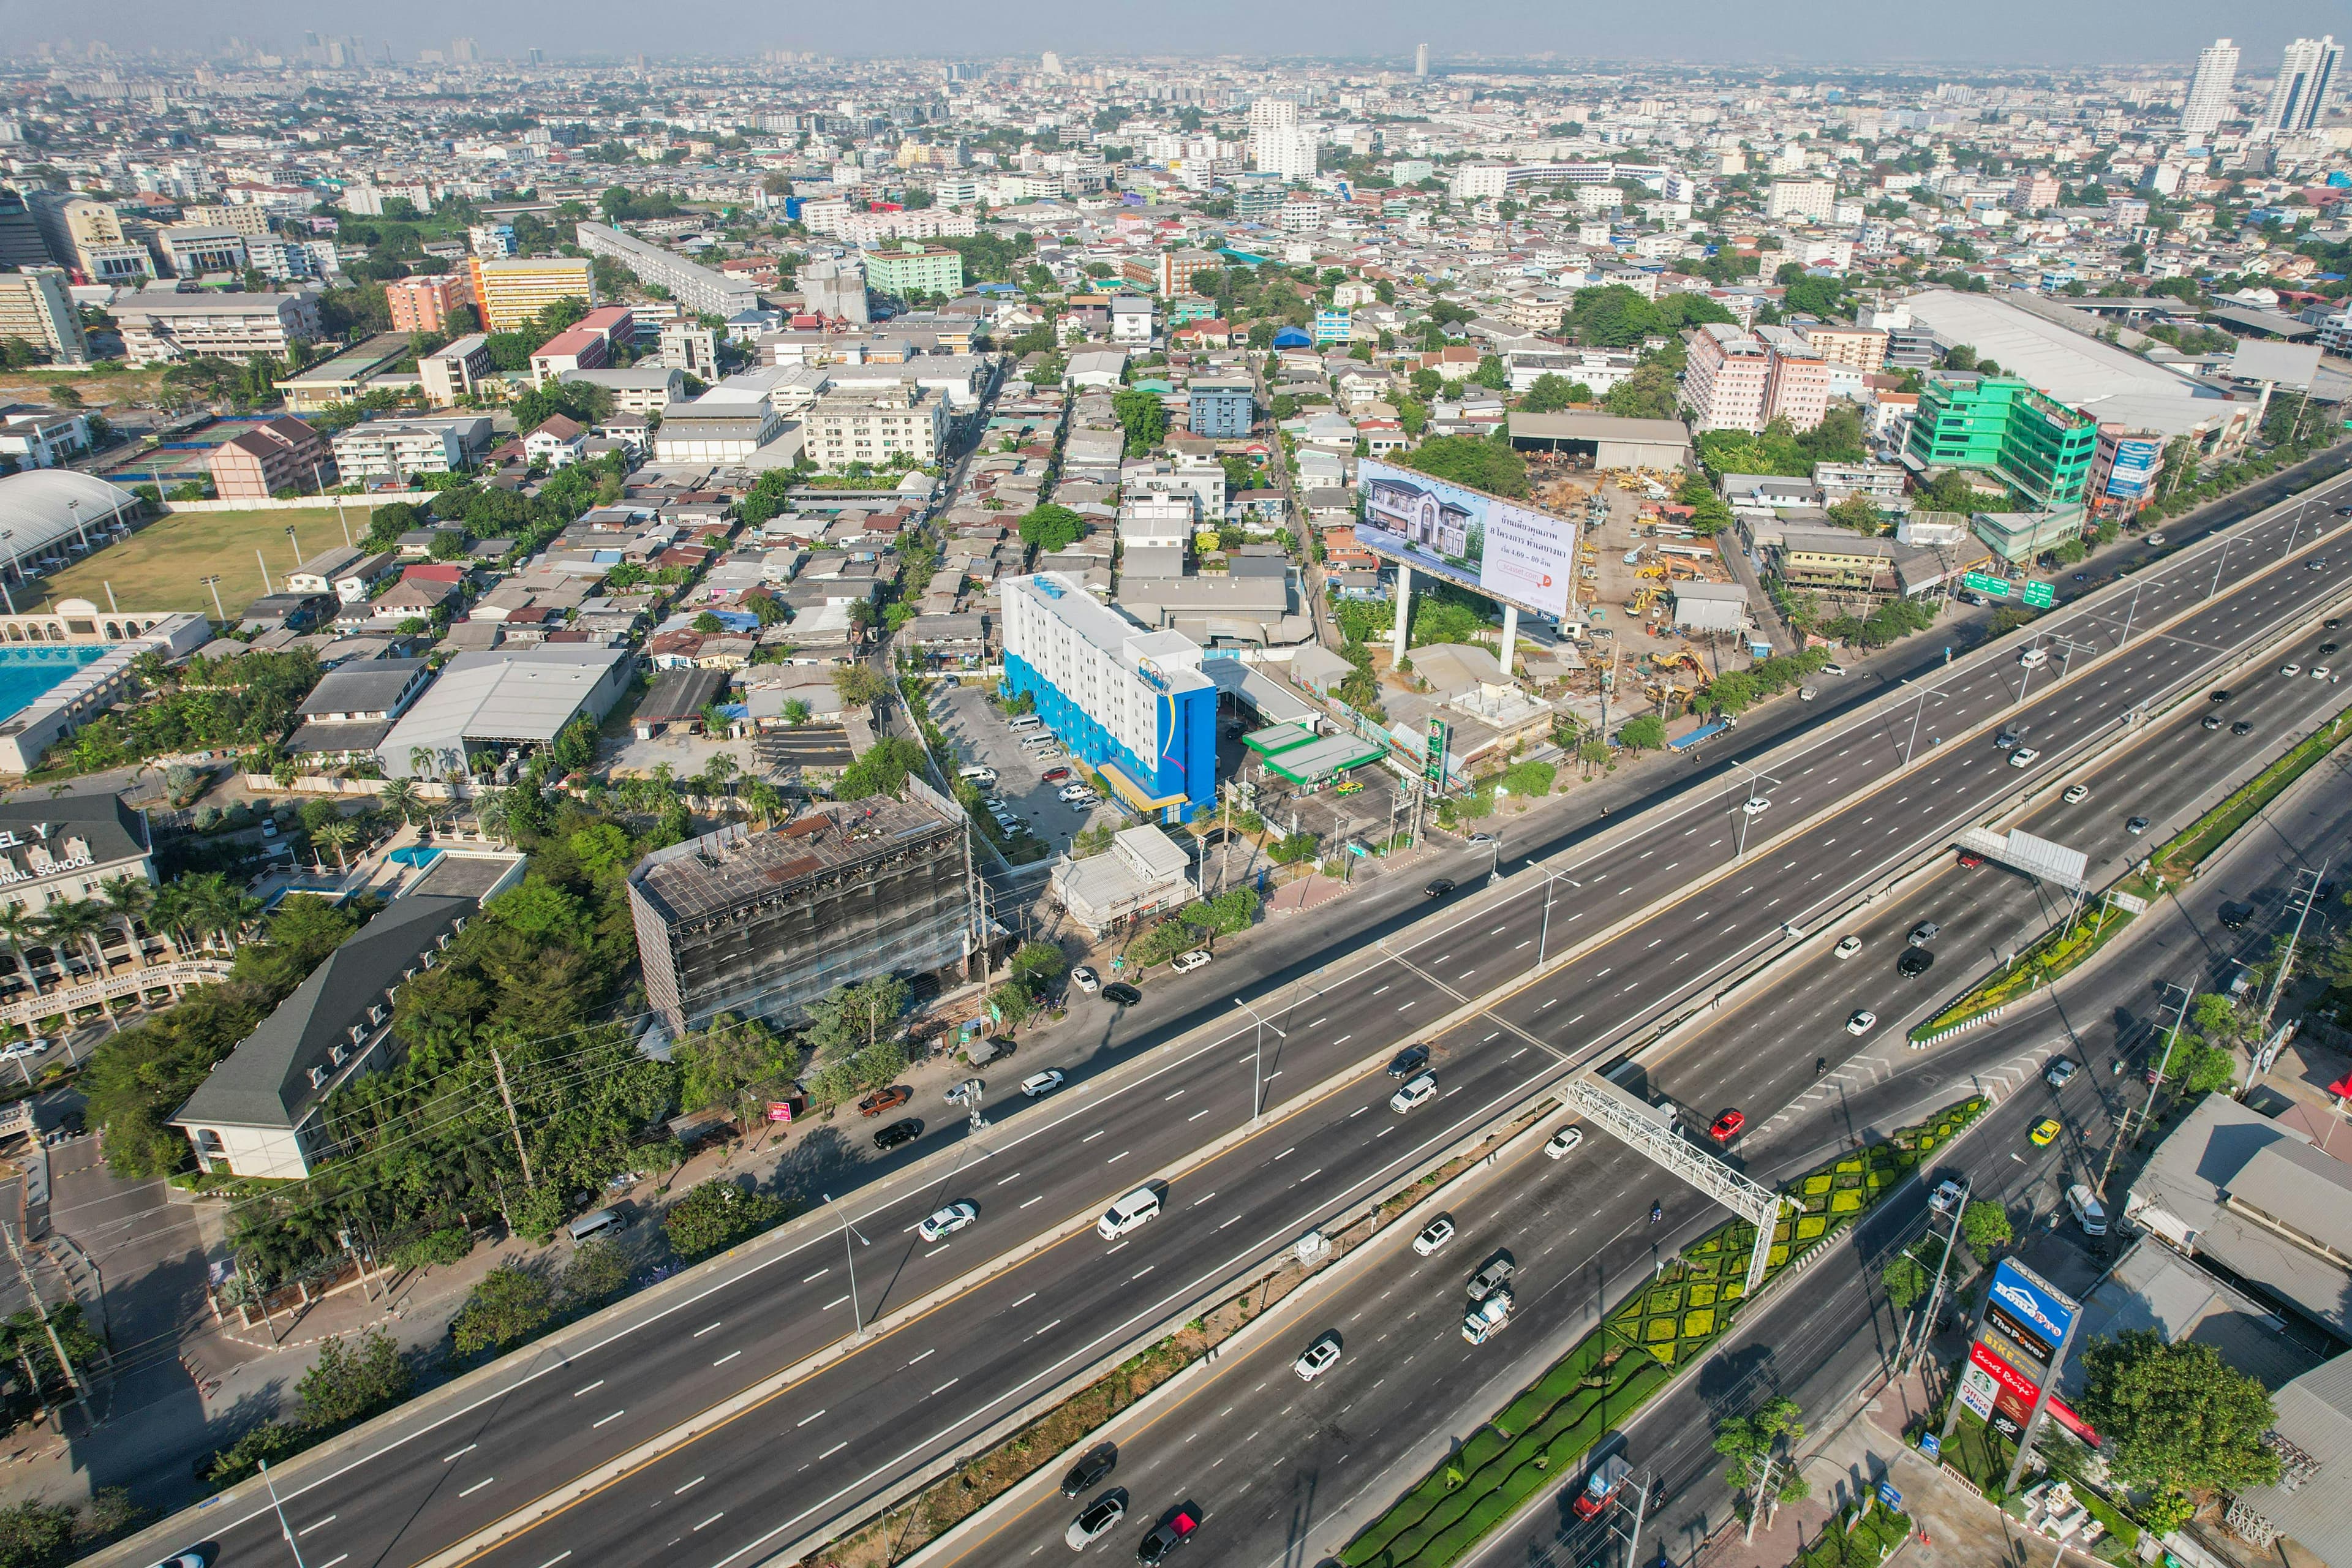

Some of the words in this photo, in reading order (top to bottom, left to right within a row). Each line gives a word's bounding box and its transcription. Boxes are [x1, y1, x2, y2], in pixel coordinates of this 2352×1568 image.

[1496, 527, 1525, 545] โครงการ
[1501, 514, 1558, 540] บ้านเดี่ยวคุณภาพ
[1511, 549, 1525, 559] 4.69
[0, 870, 32, 886] NAL
[36, 855, 95, 876] SCHOOL
[1994, 1281, 2062, 1336] HomePro
[1985, 1334, 2014, 1362] BIKE
[1975, 1351, 2001, 1373] Secret
[1962, 1385, 1989, 1409] Office
[1965, 1396, 1986, 1415] Mate
